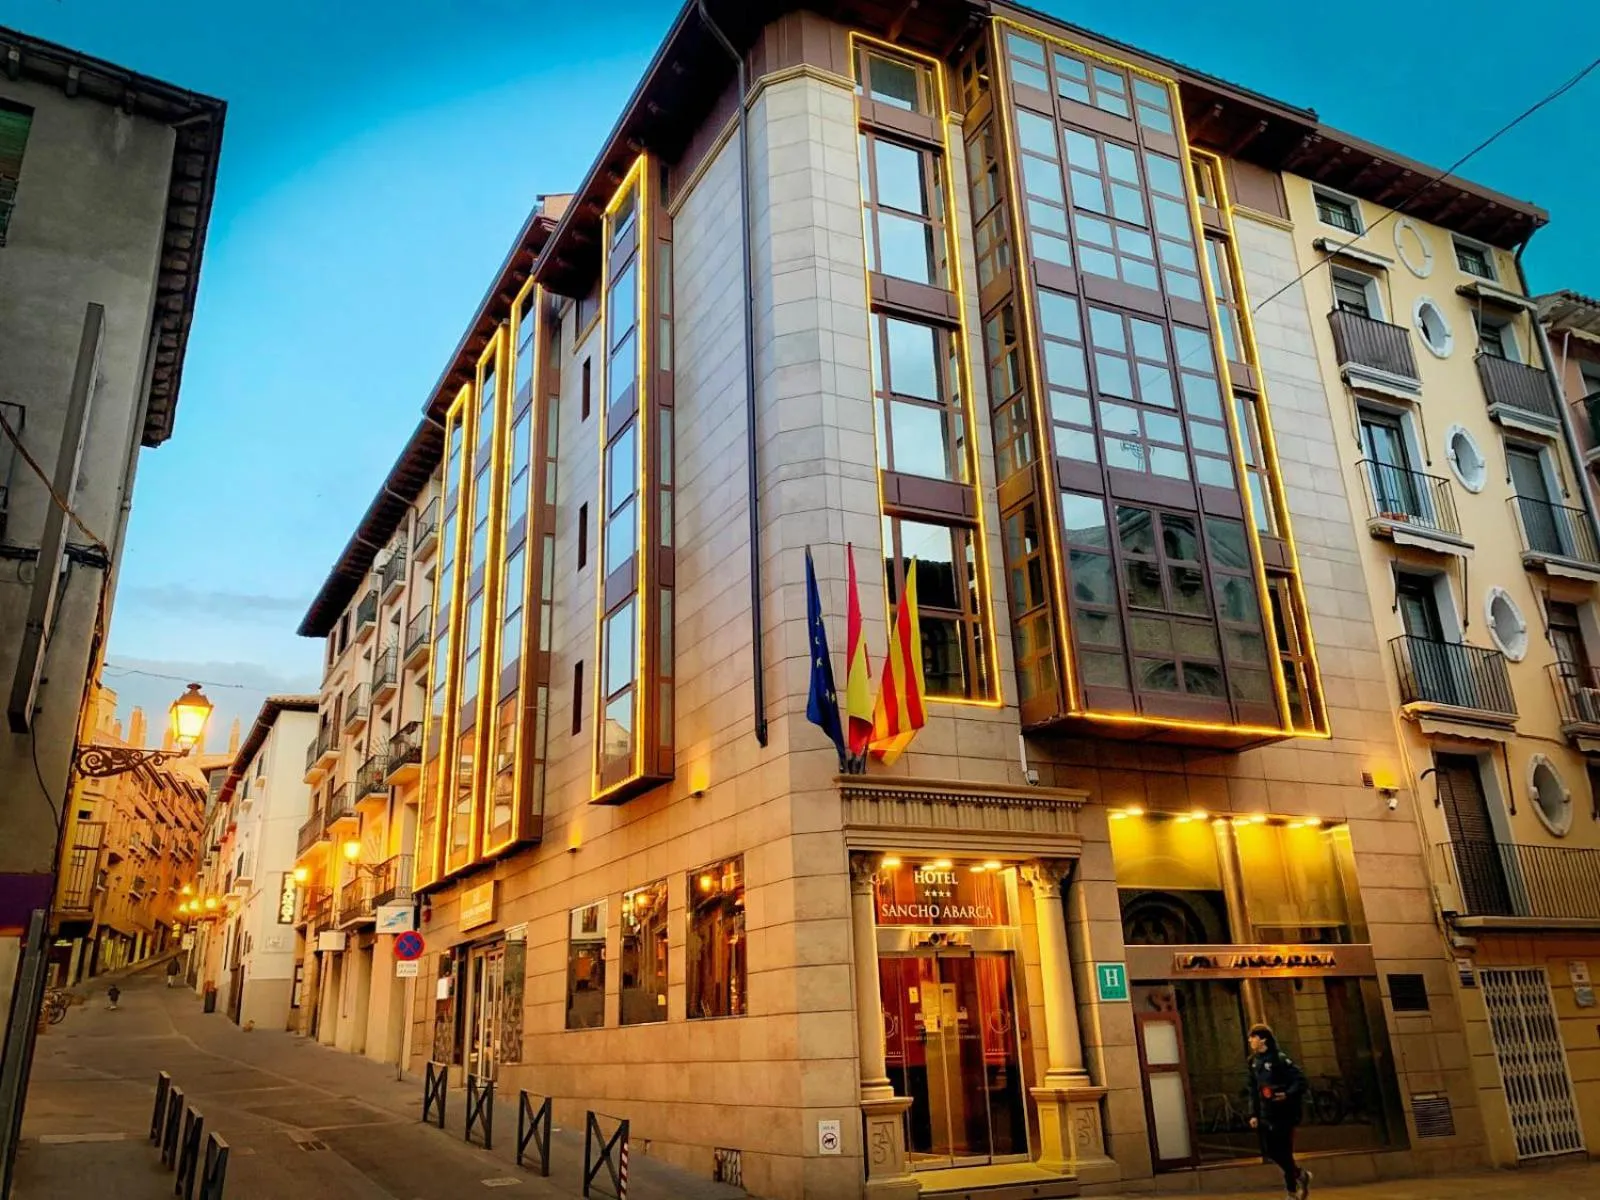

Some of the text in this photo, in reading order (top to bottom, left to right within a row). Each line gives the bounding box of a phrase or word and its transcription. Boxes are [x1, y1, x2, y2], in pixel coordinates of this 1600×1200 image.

[914, 871, 958, 885] HOTEL
[881, 904, 993, 919] SANCHO ABARCA
[1104, 968, 1120, 987] H
